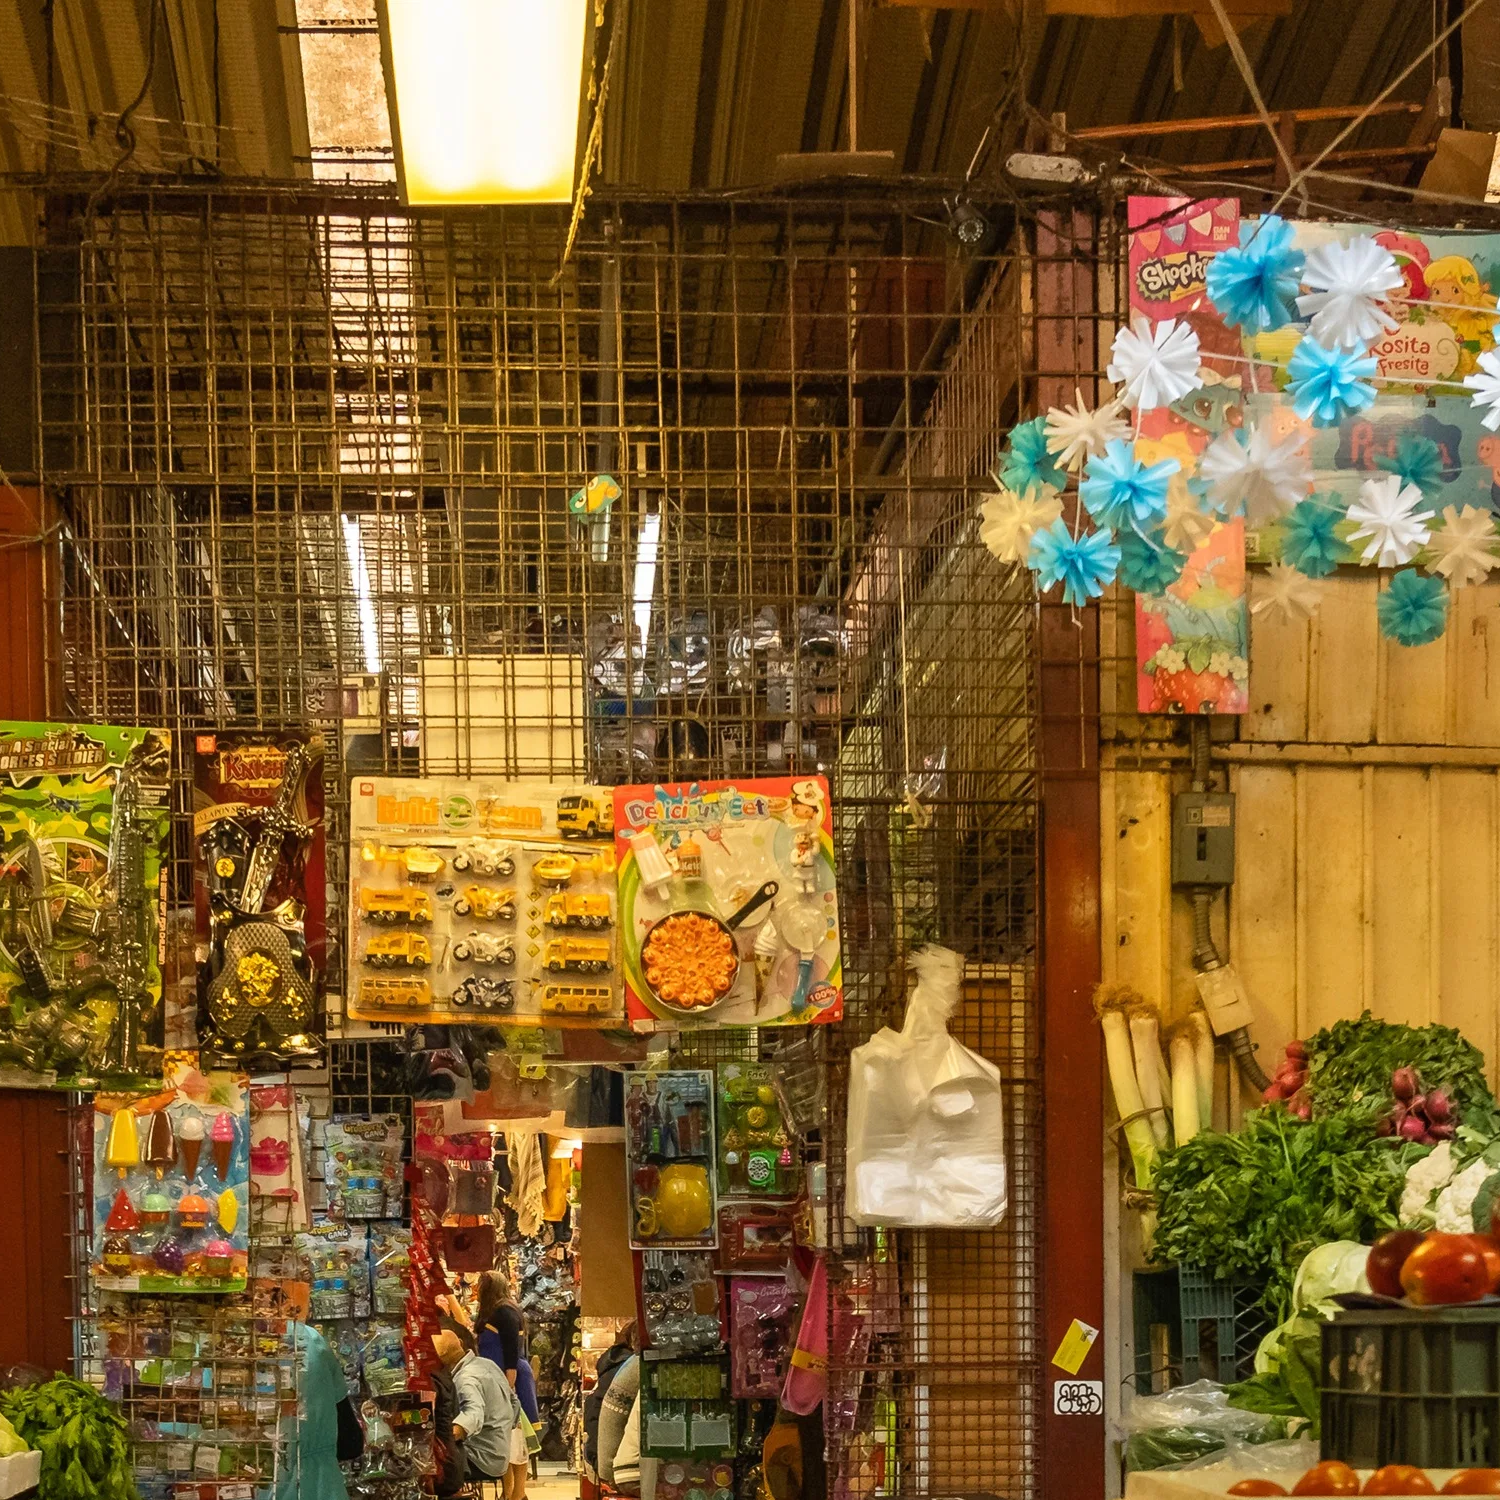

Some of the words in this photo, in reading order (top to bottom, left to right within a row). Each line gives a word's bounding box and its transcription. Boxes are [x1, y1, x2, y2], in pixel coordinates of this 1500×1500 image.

[1141, 254, 1207, 291] Shopki
[1377, 355, 1430, 377] Fresita
[47, 748, 106, 767] SOLDIER
[729, 795, 766, 818] Set
[810, 987, 837, 1002] 100%
[364, 1129, 385, 1139] GANG
[327, 1229, 348, 1240] GANG
